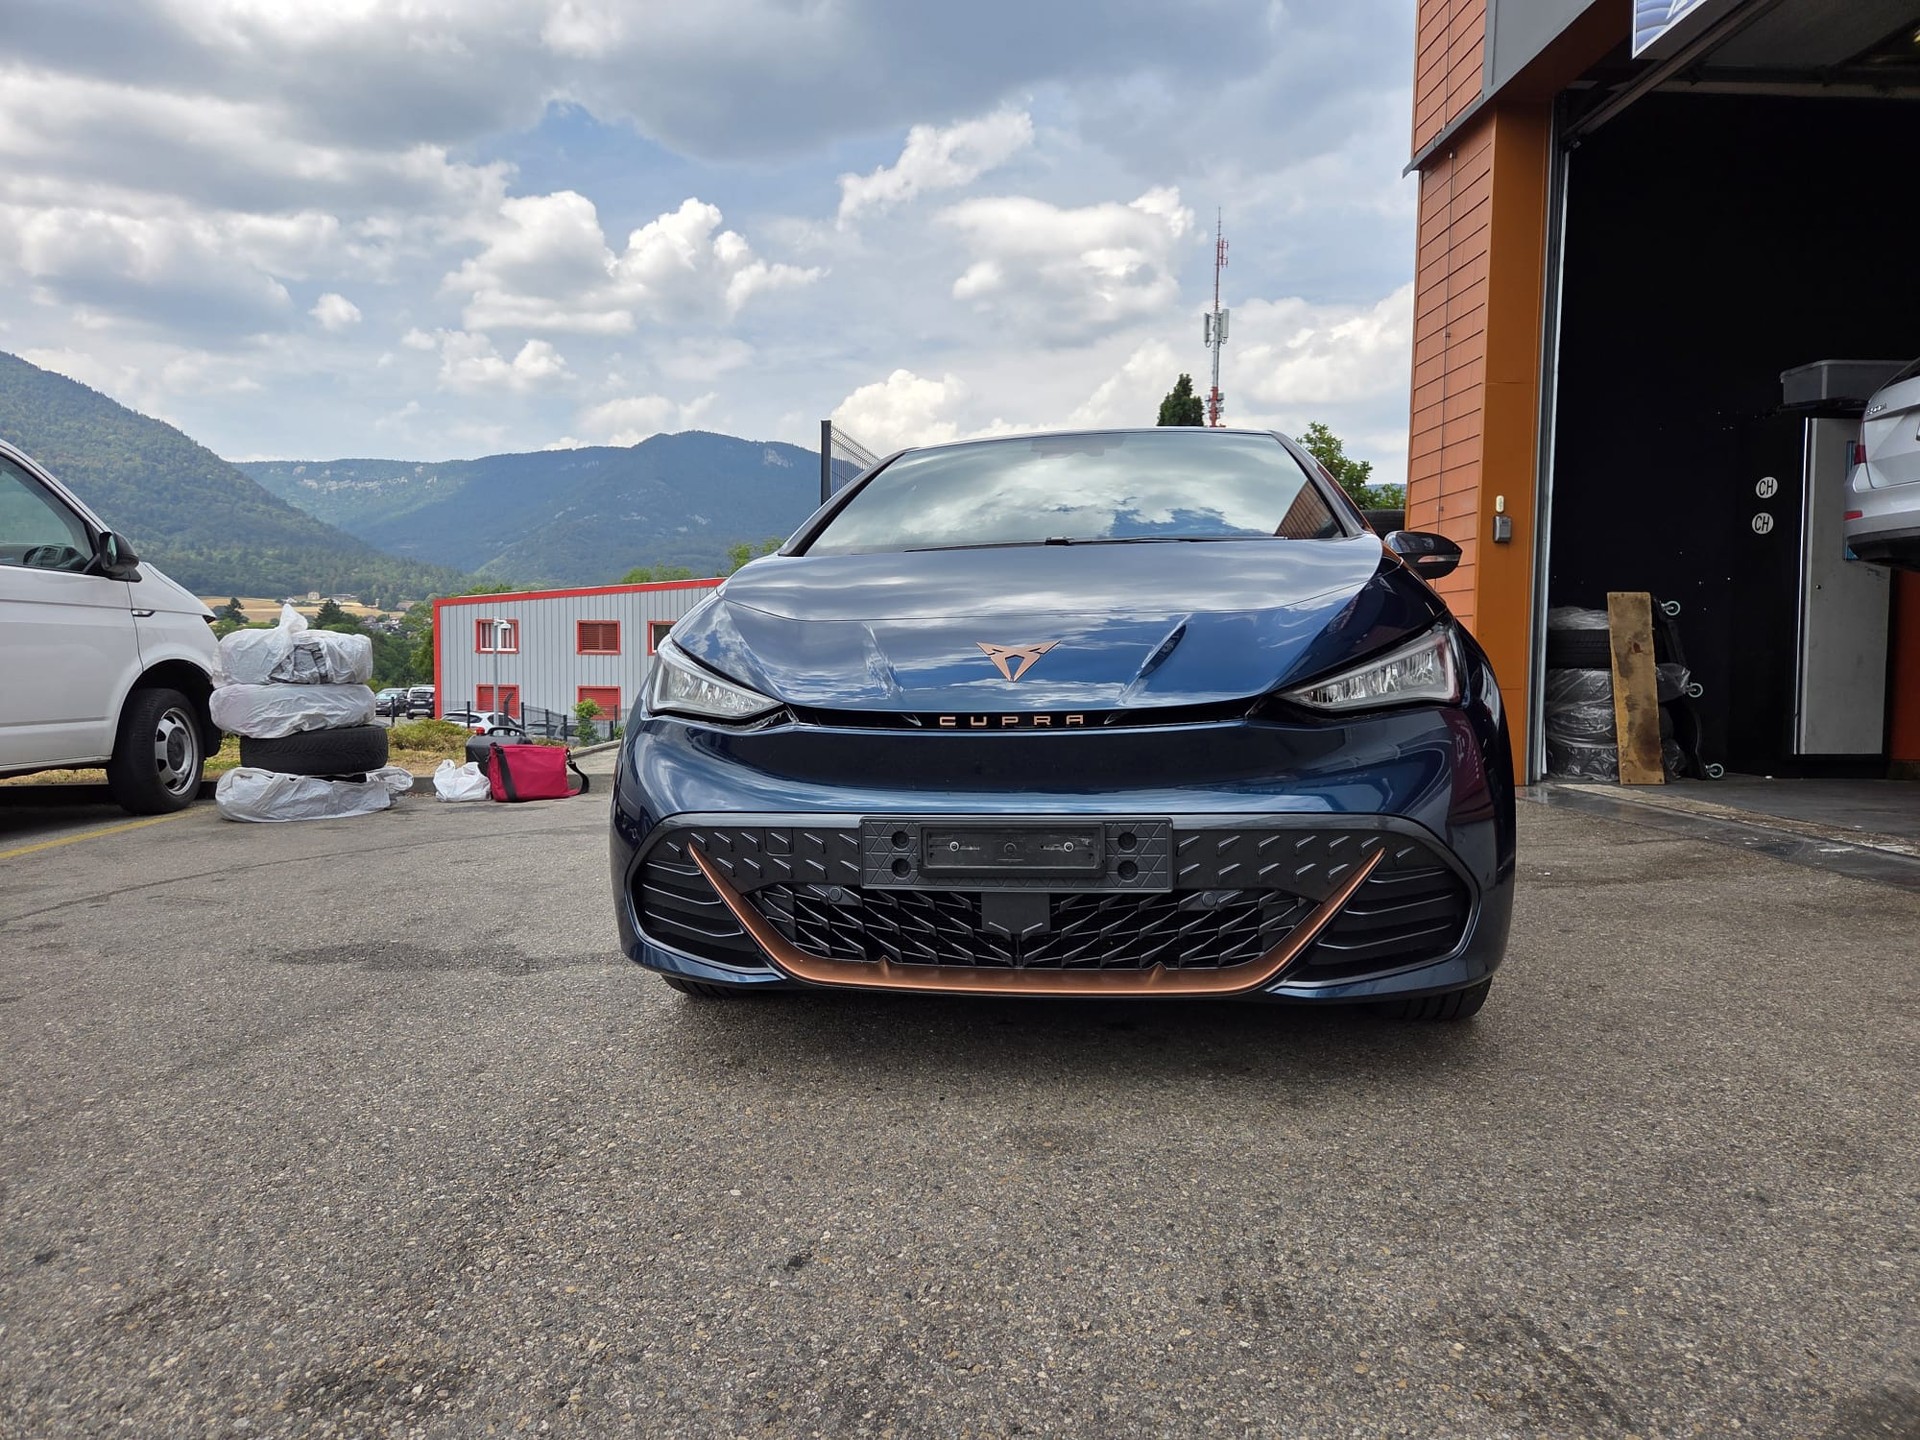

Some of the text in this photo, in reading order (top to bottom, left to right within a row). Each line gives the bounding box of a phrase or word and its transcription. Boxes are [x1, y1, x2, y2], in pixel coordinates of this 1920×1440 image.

[1758, 479, 1774, 496] CH
[1754, 515, 1770, 532] CH
[939, 714, 1084, 726] CUPRA
